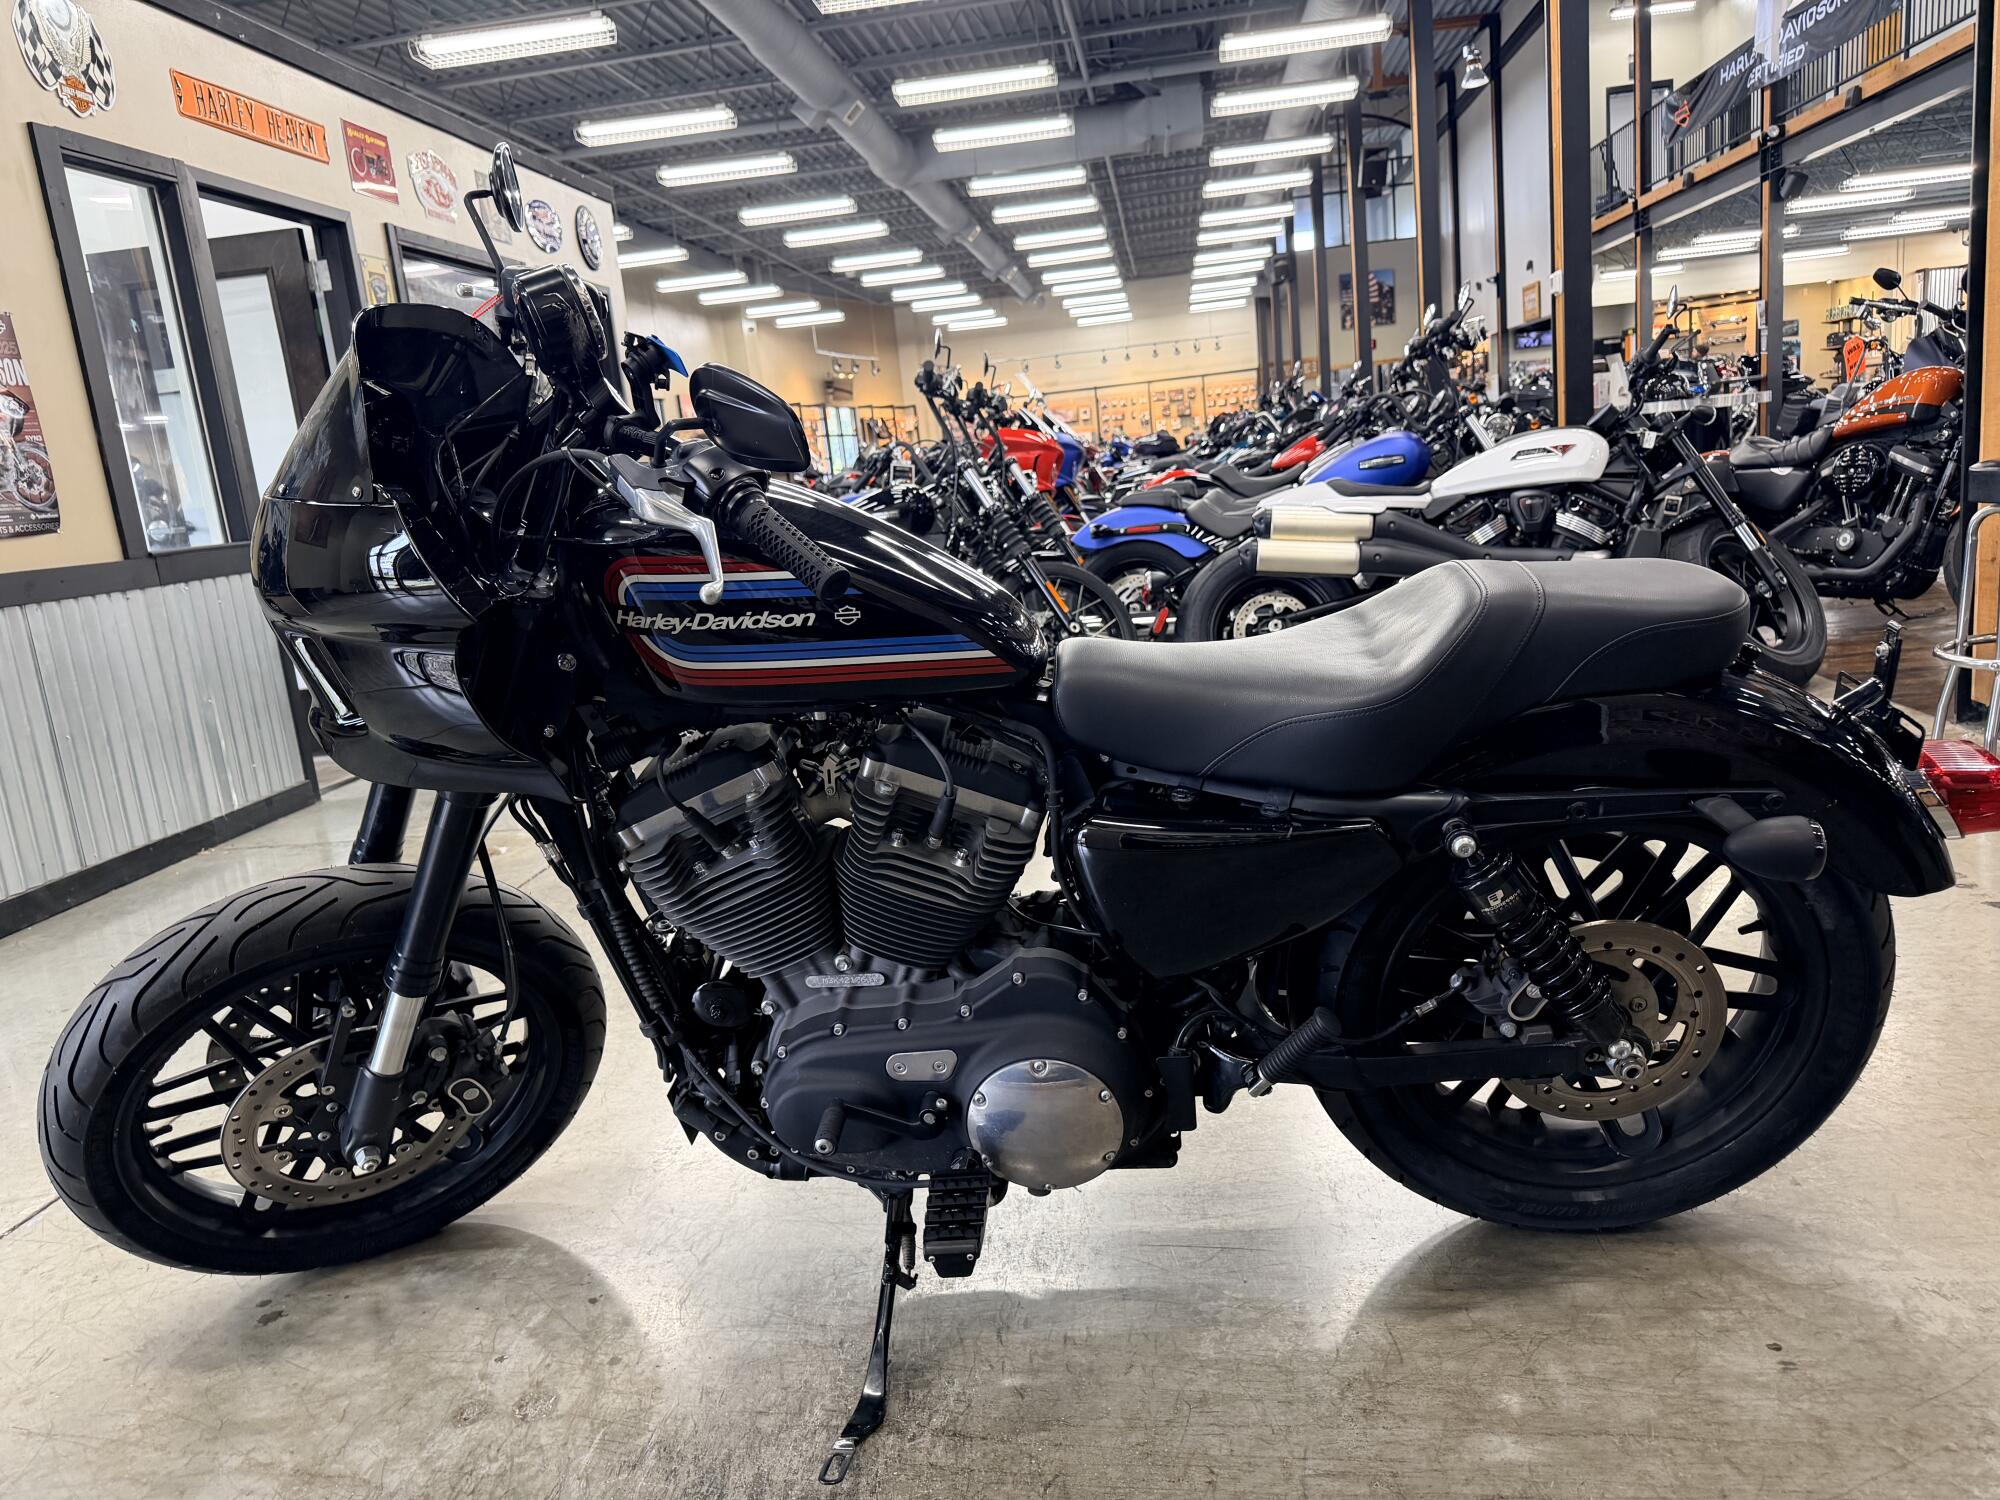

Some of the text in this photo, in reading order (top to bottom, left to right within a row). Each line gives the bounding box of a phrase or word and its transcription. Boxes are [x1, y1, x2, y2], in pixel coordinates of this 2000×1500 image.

[193, 81, 317, 155] HARLEY HEAVEN
[15, 522, 59, 534] ACCESSORIES
[617, 609, 815, 636] Harley-Davidson
